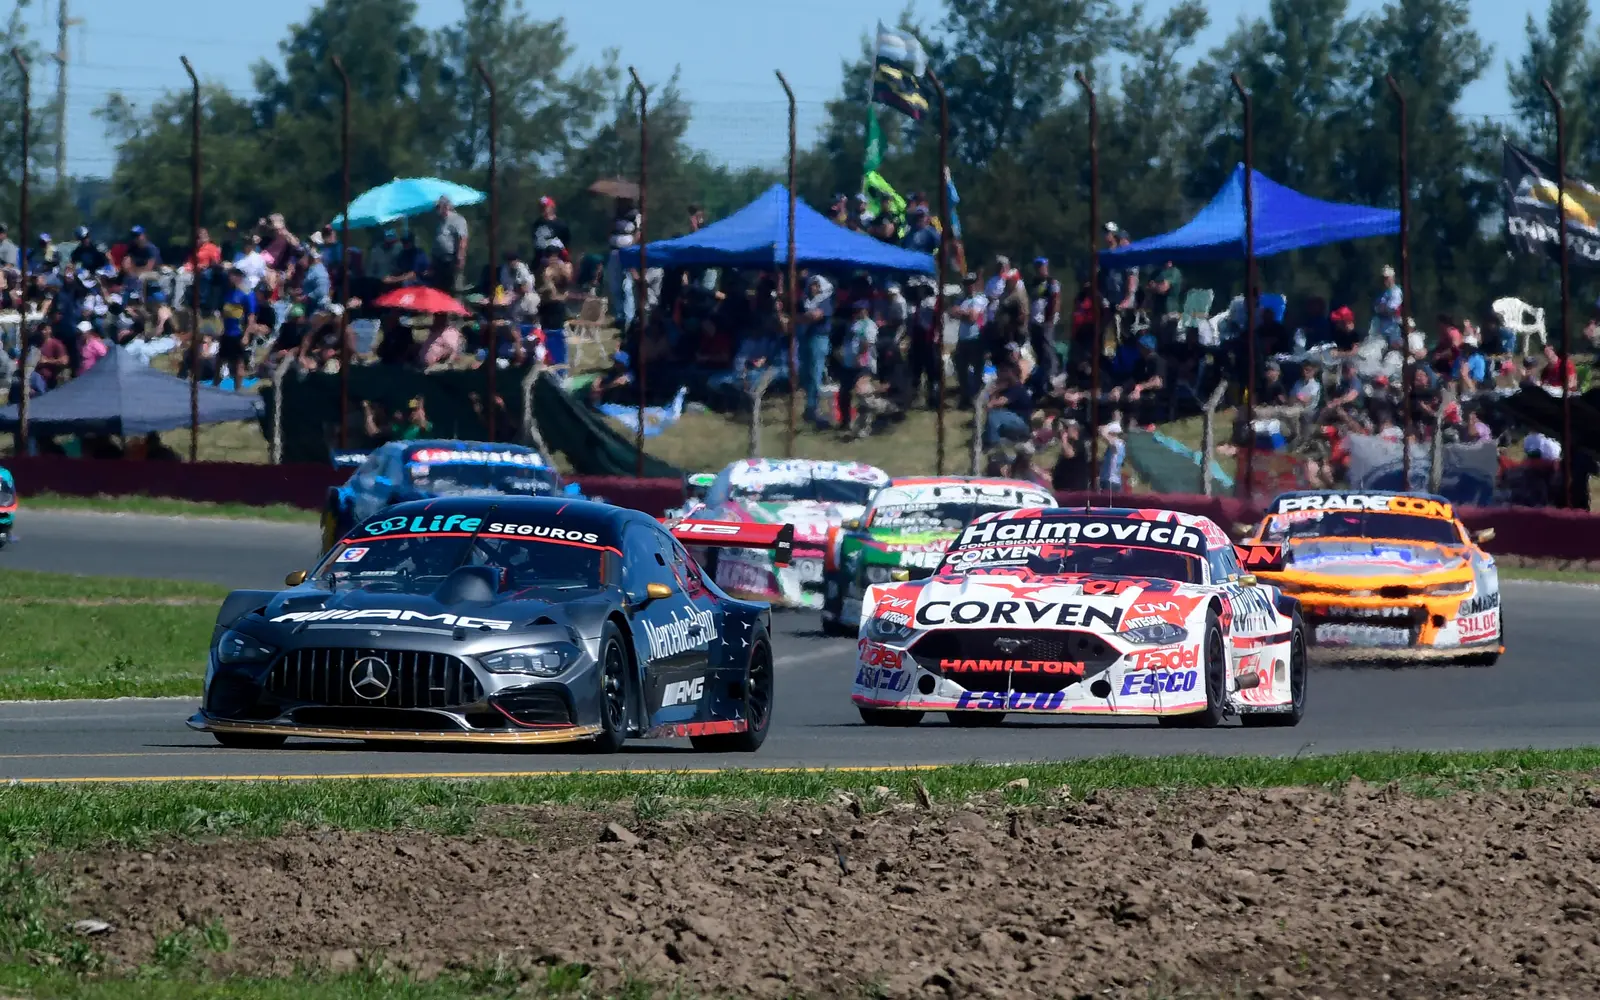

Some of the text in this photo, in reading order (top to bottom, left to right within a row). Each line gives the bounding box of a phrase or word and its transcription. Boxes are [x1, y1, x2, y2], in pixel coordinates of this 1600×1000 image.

[410, 514, 598, 543] Life SEGUROS
[960, 519, 1200, 550] Haimovich
[946, 545, 1041, 564] CORVEN
[959, 538, 1076, 551] CONCESIONARIAS
[915, 600, 1124, 634] CORVEN
[1125, 615, 1167, 629] INTEGRA
[940, 659, 1085, 675] HAMILTON
[1129, 644, 1200, 671] Fadel
[1120, 671, 1198, 695] ESCO
